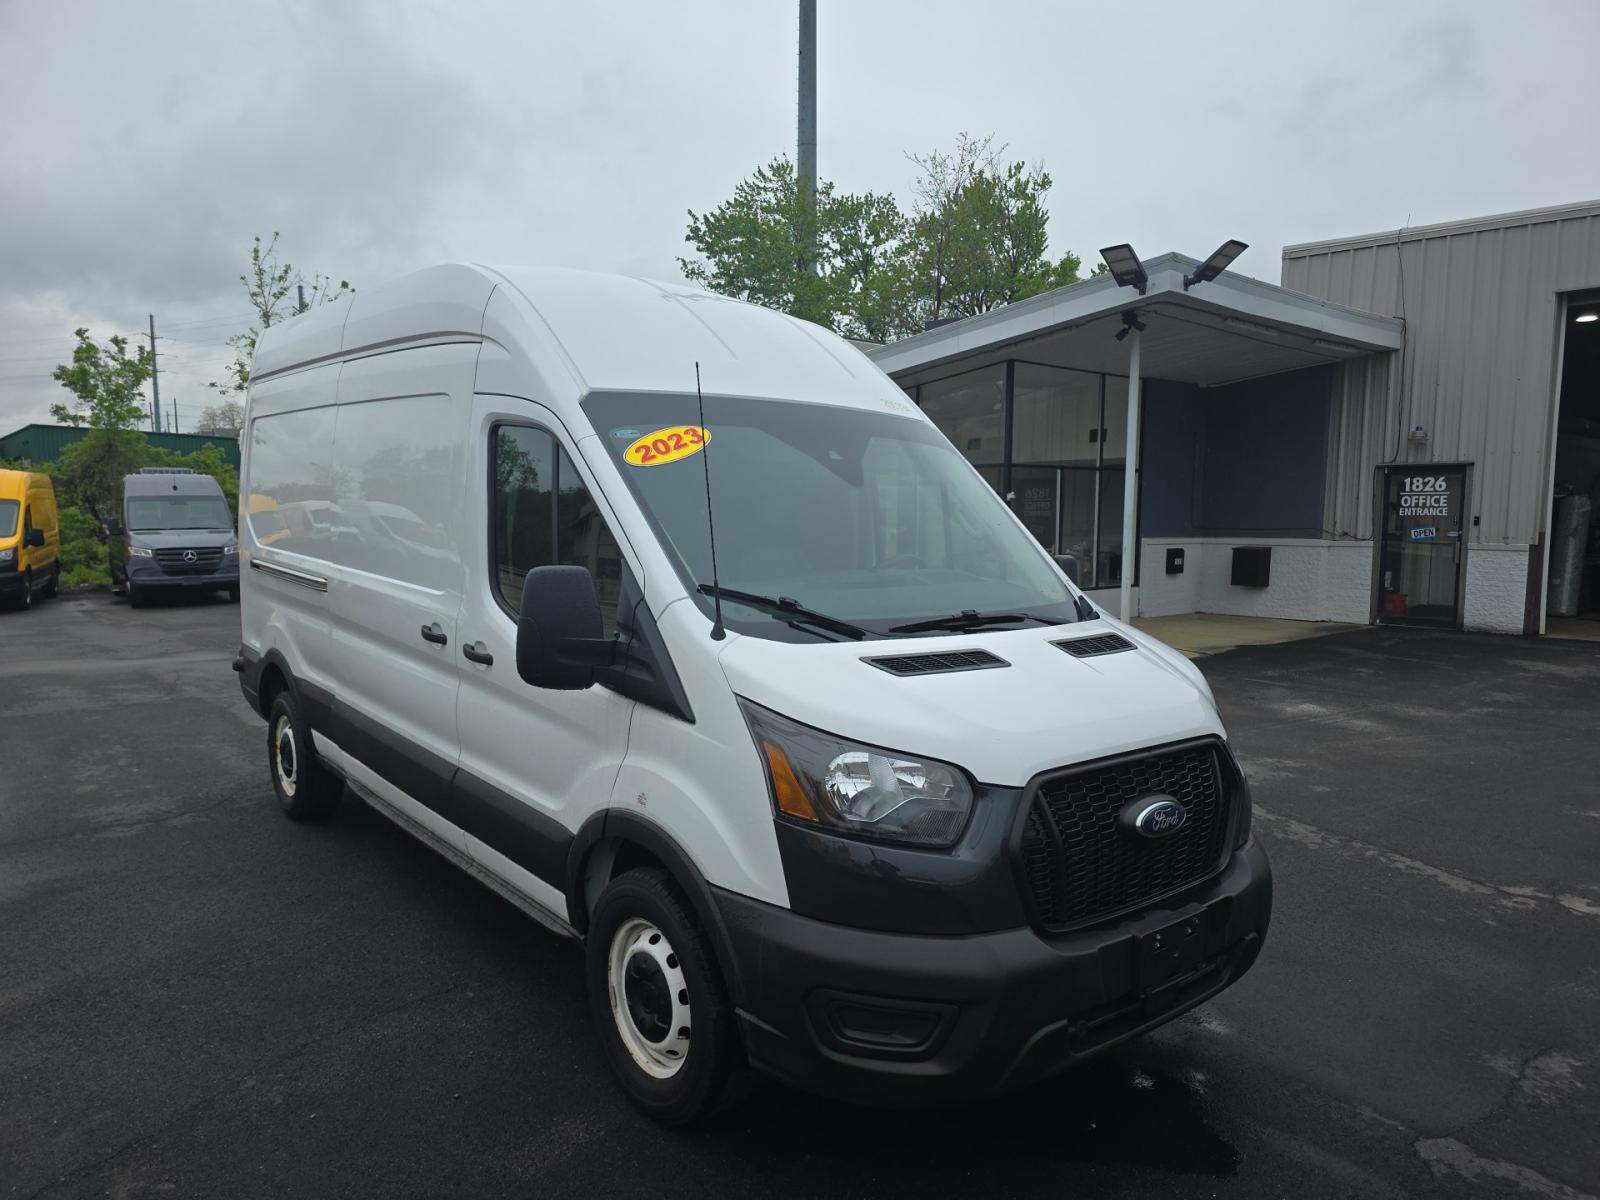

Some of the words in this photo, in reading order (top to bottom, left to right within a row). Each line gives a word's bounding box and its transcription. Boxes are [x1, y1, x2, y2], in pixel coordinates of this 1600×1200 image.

[635, 428, 704, 464] 2023
[1404, 476, 1447, 492] 1826
[1401, 495, 1448, 507] OFFICE
[1399, 507, 1448, 516] ENTRANCE
[1412, 528, 1435, 538] OPEN
[1152, 808, 1179, 831] Ford
